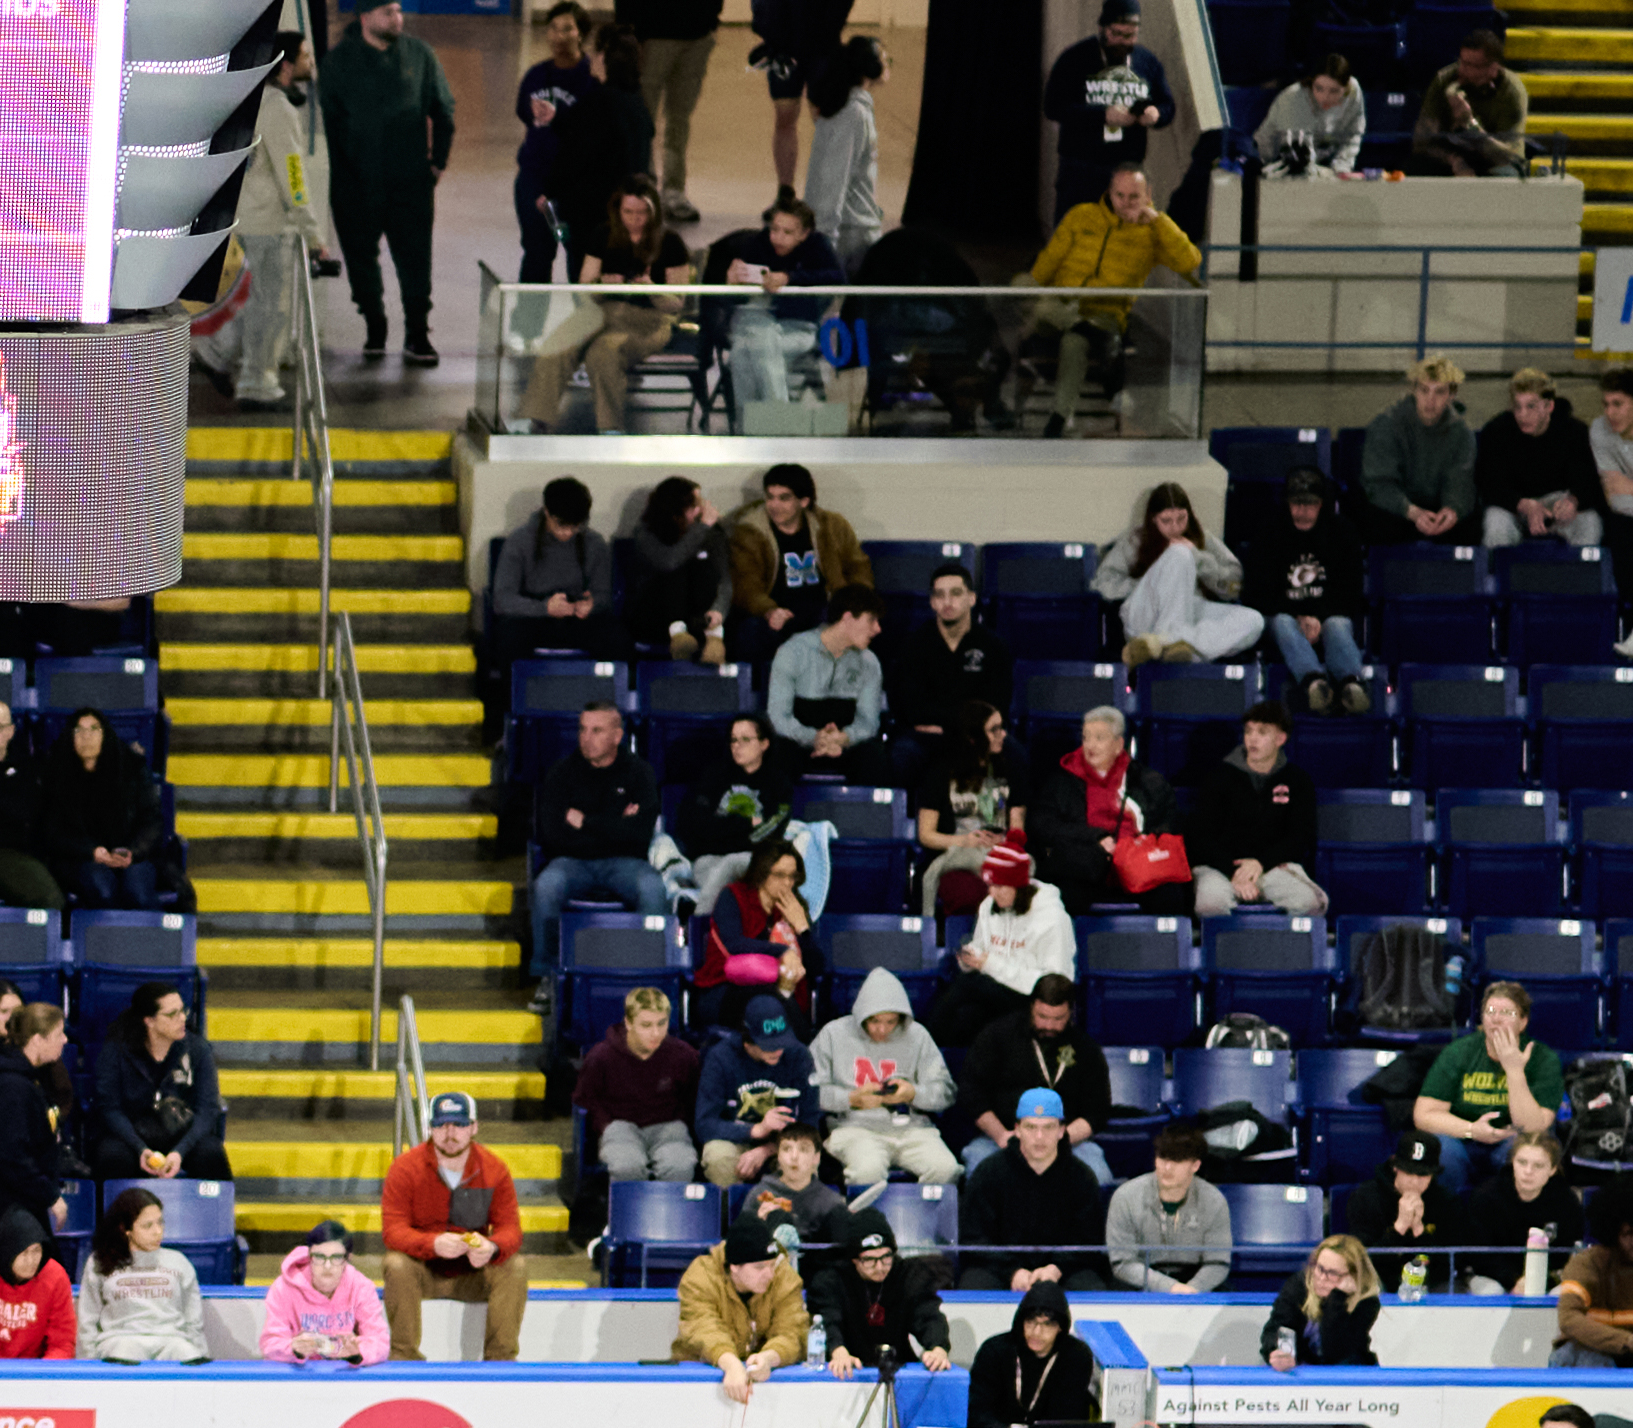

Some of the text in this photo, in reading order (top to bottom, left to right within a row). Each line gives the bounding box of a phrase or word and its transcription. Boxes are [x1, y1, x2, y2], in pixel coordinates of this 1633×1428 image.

[1163, 1398, 1401, 1416] Against Pests All Year Long
